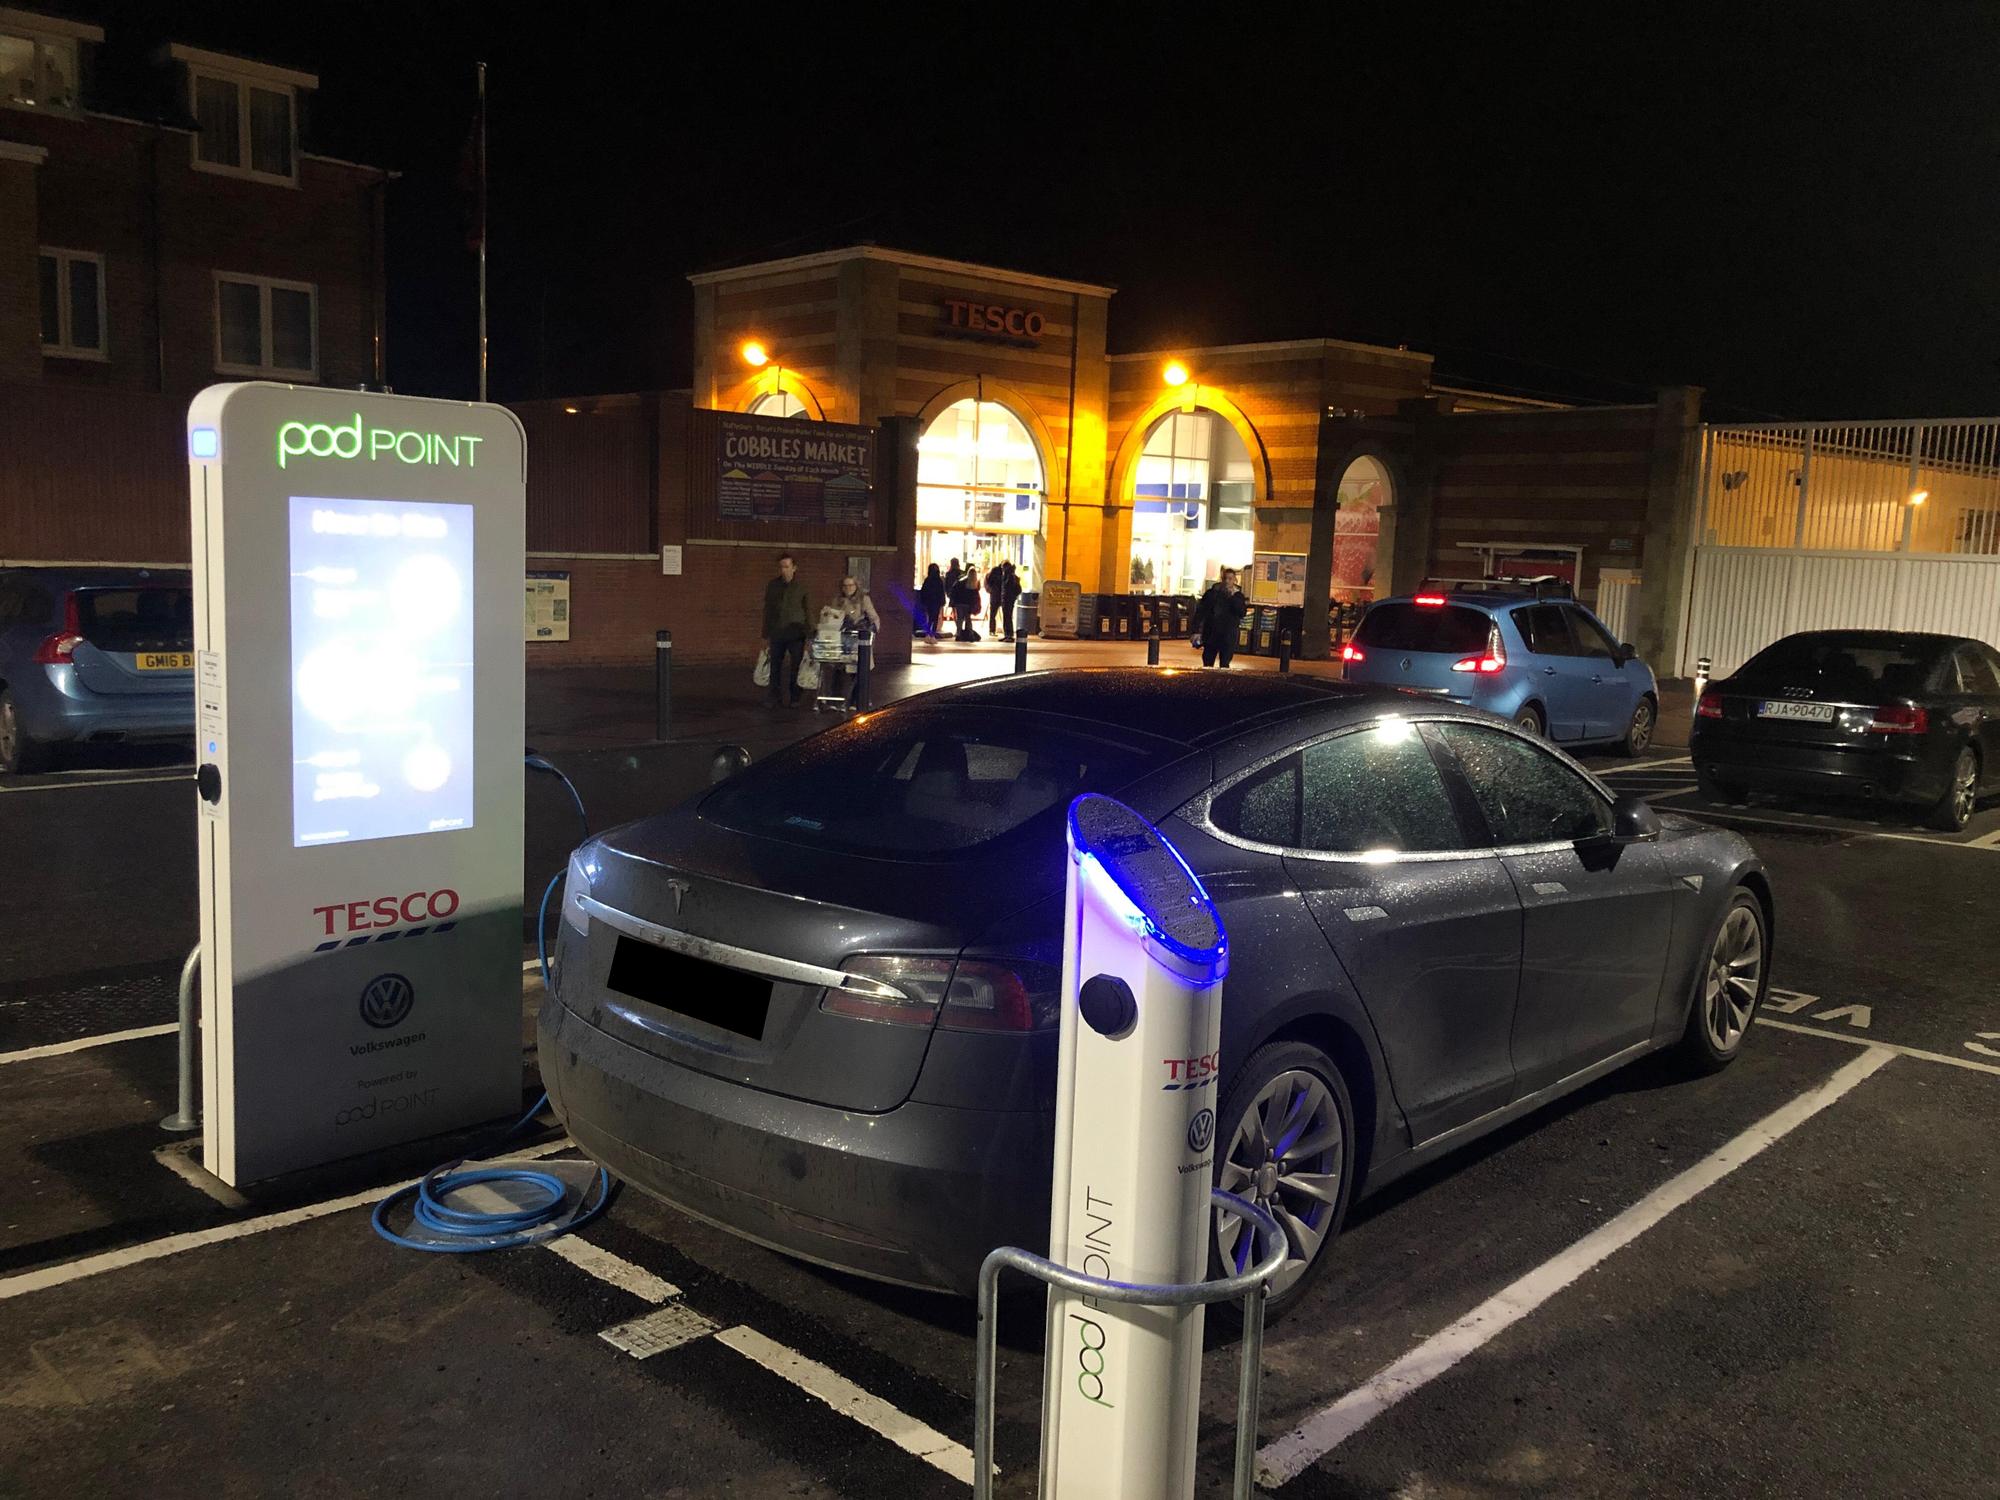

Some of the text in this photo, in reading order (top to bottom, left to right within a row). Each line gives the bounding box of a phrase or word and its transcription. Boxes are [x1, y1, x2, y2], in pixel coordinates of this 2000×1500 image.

[945, 299, 1045, 337] TESCO
[279, 413, 483, 469] pod POINT
[726, 436, 866, 465] COBBLES MARKET
[145, 654, 178, 667] GM16
[313, 889, 460, 935] TESCO
[350, 1032, 426, 1056] Volkswagen
[358, 1069, 419, 1089] Powered by
[1163, 1050, 1220, 1081] TESC
[335, 1087, 440, 1129] pod POINT
